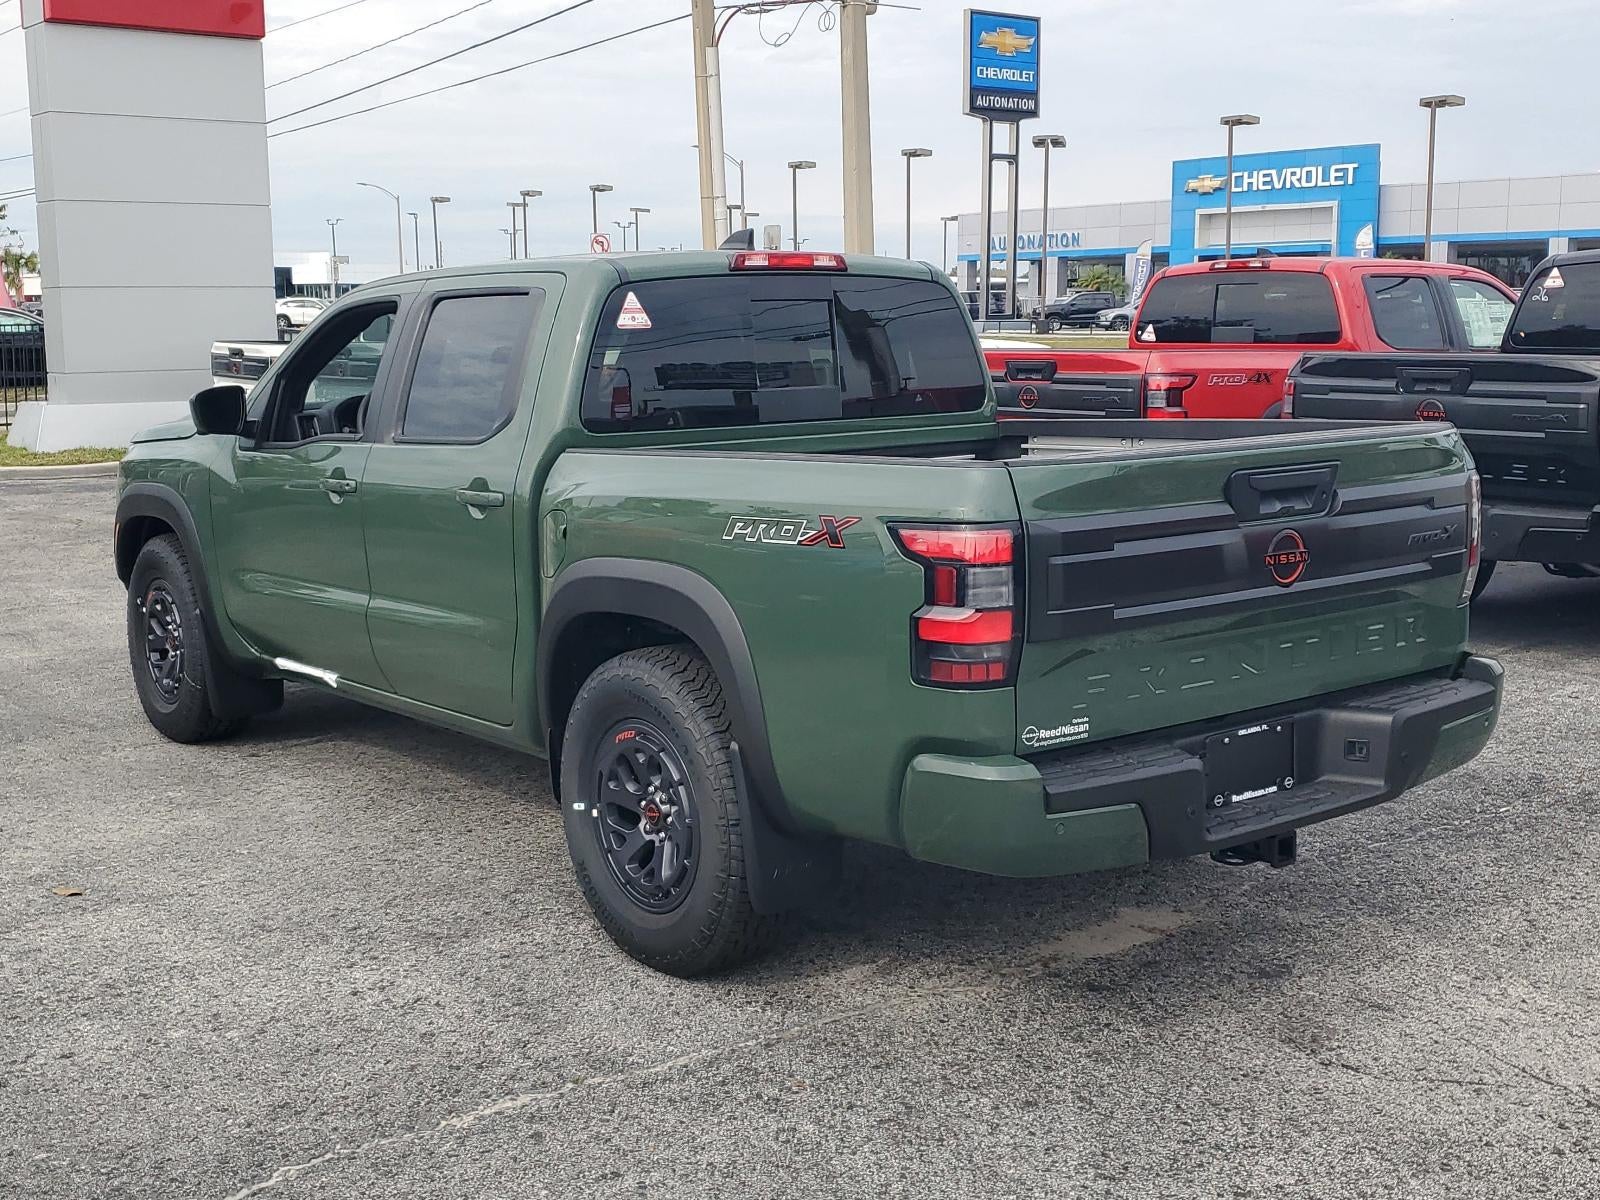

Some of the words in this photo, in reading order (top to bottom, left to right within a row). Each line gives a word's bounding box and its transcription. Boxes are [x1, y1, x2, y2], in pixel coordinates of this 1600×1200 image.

[976, 66, 1035, 82] CHEVROLET
[976, 95, 1035, 110] AUTONATION
[1230, 163, 1359, 193] CHEVROLET
[991, 232, 1080, 251] AUONATION
[1532, 286, 1549, 302] 26
[1264, 552, 1310, 566] NISSAN
[1232, 786, 1277, 802] ReedNissan.com
